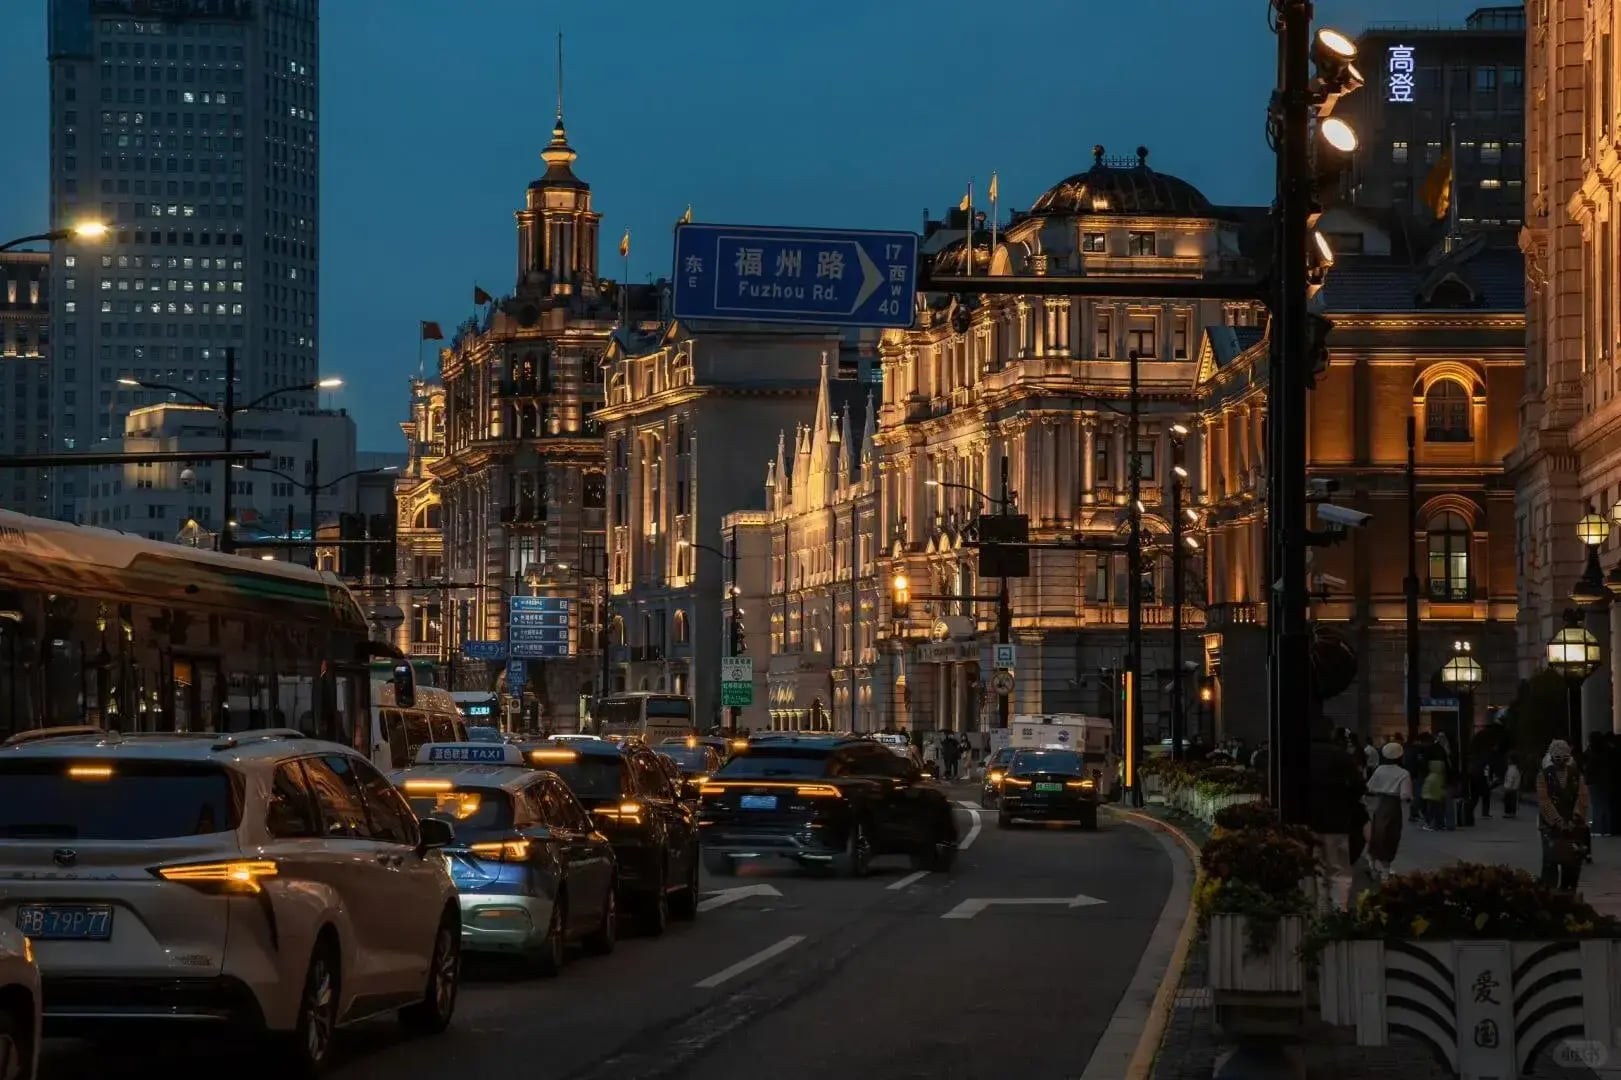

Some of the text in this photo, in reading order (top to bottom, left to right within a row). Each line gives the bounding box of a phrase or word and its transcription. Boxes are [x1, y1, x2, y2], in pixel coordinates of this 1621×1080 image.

[1388, 43, 1416, 102] 高登
[885, 244, 903, 261] 17
[685, 255, 703, 274] 东
[735, 247, 846, 281] 福州路
[688, 276, 698, 288] E
[888, 264, 907, 283] 西
[738, 284, 839, 301] Fuzhou Rd.
[890, 285, 902, 297] W
[878, 300, 900, 316] 40
[471, 750, 500, 760] TAXI
[1472, 970, 1501, 1049] 爱国
